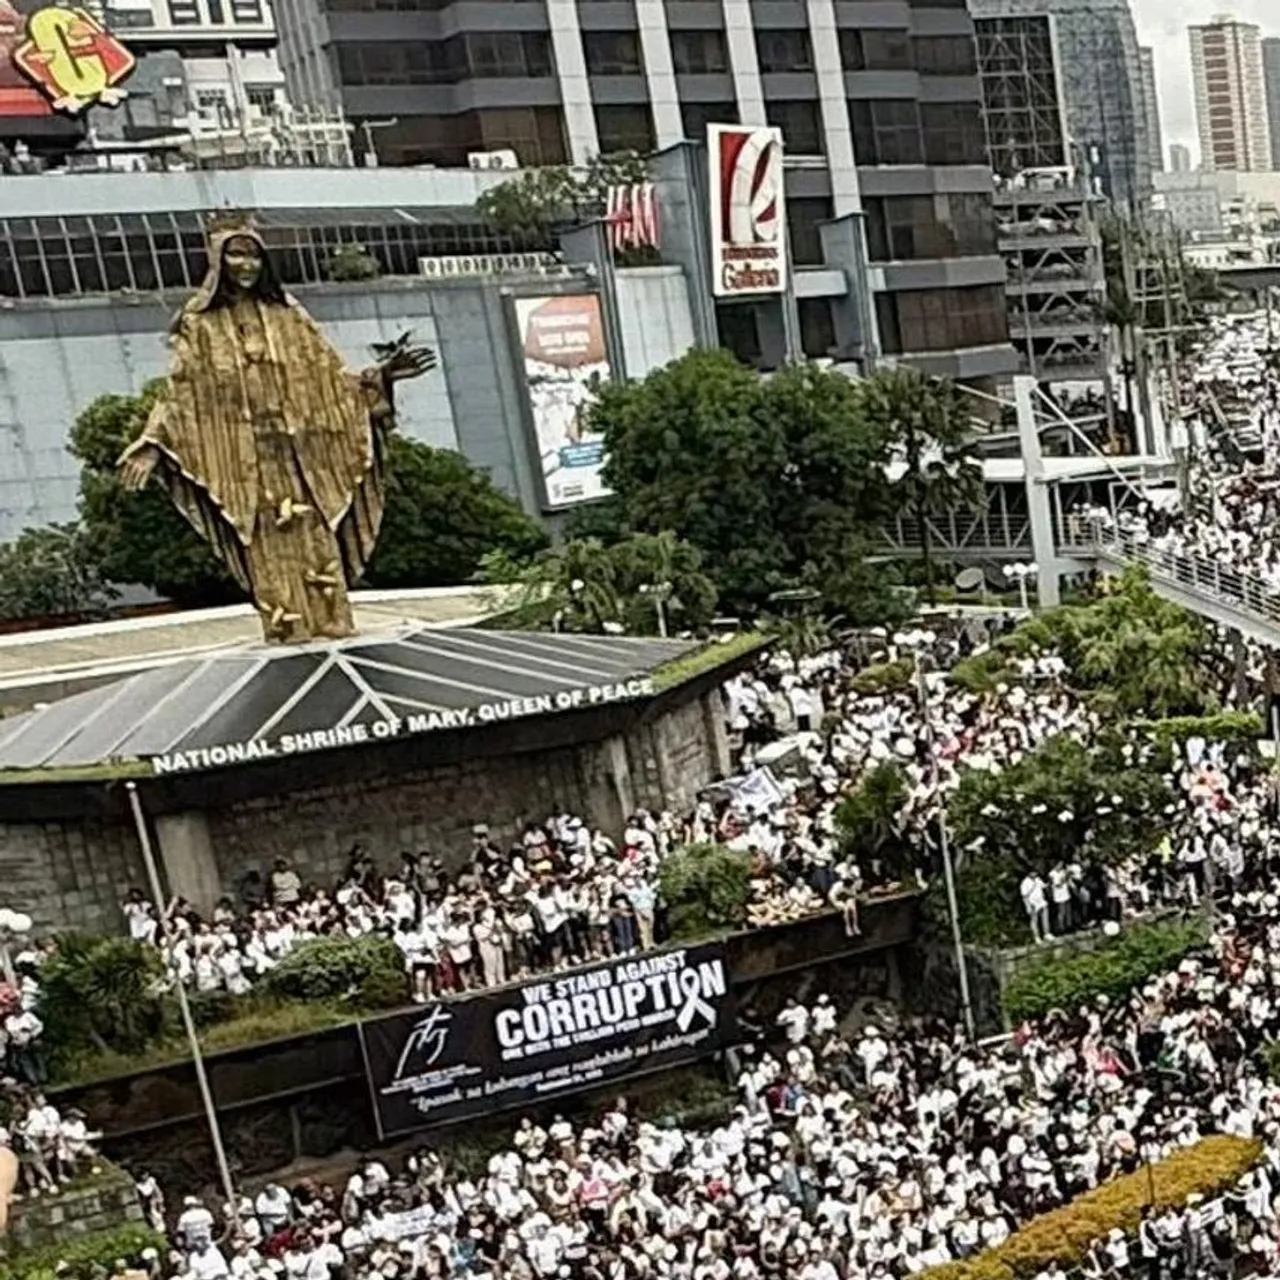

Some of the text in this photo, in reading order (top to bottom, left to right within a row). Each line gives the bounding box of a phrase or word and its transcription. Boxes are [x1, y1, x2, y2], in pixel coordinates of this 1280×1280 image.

[151, 678, 655, 775] NATIONAL SHRINE OF MARY, QUEEN OF PEACE
[494, 959, 727, 1049] CORRUPTION
[521, 950, 688, 1005] WE STAND AGAINST
